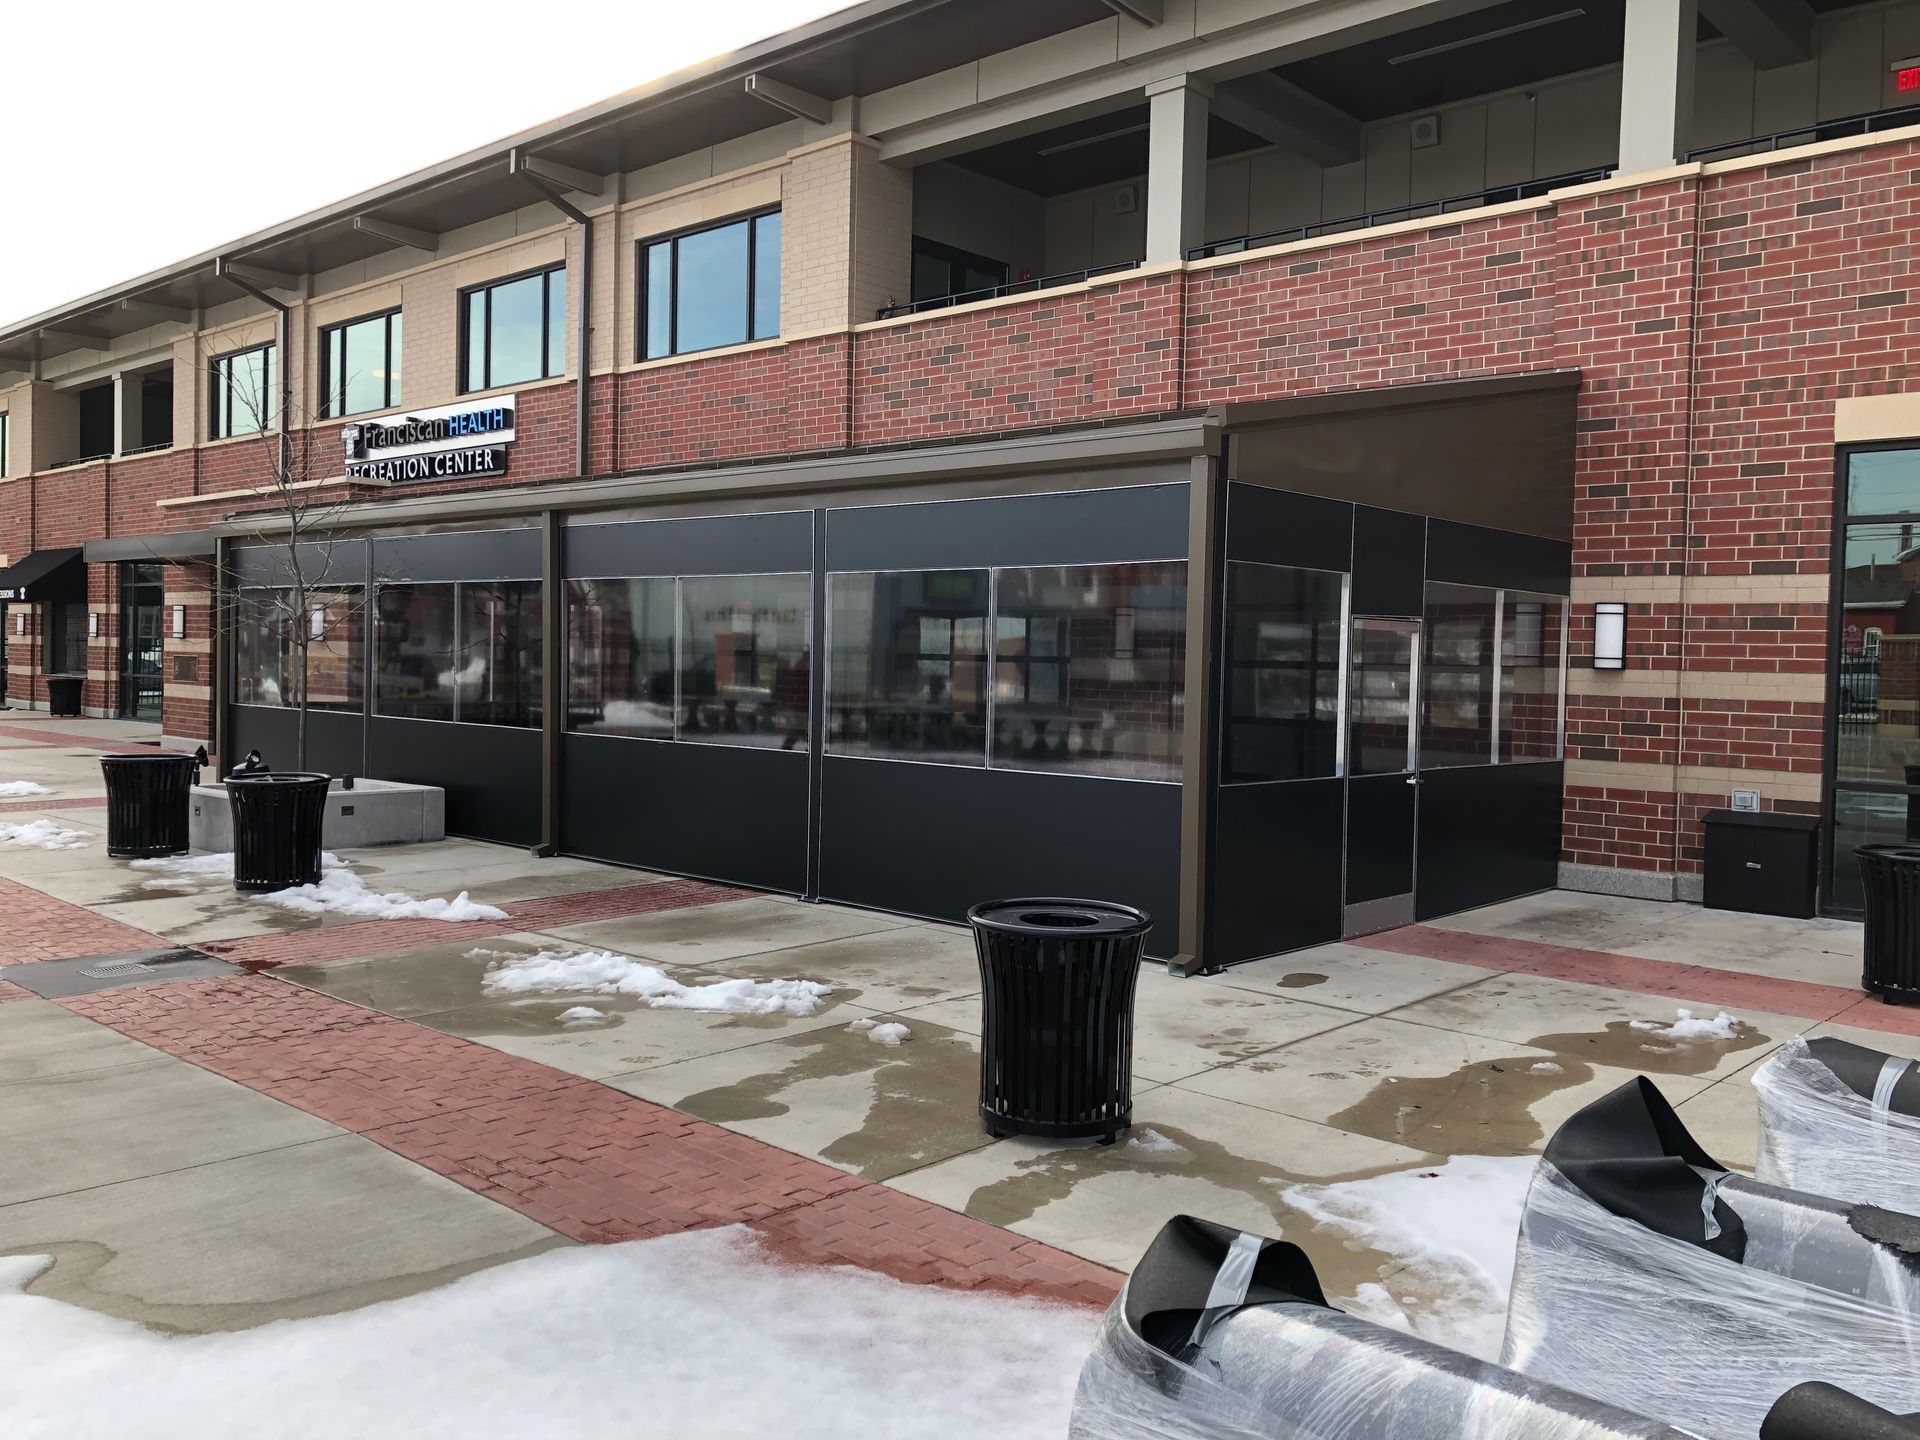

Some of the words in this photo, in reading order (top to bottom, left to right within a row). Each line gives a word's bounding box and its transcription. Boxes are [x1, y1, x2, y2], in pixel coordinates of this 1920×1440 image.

[363, 417, 444, 449] Franciscan
[449, 407, 505, 436] HEALTH
[434, 448, 494, 476] CENTER
